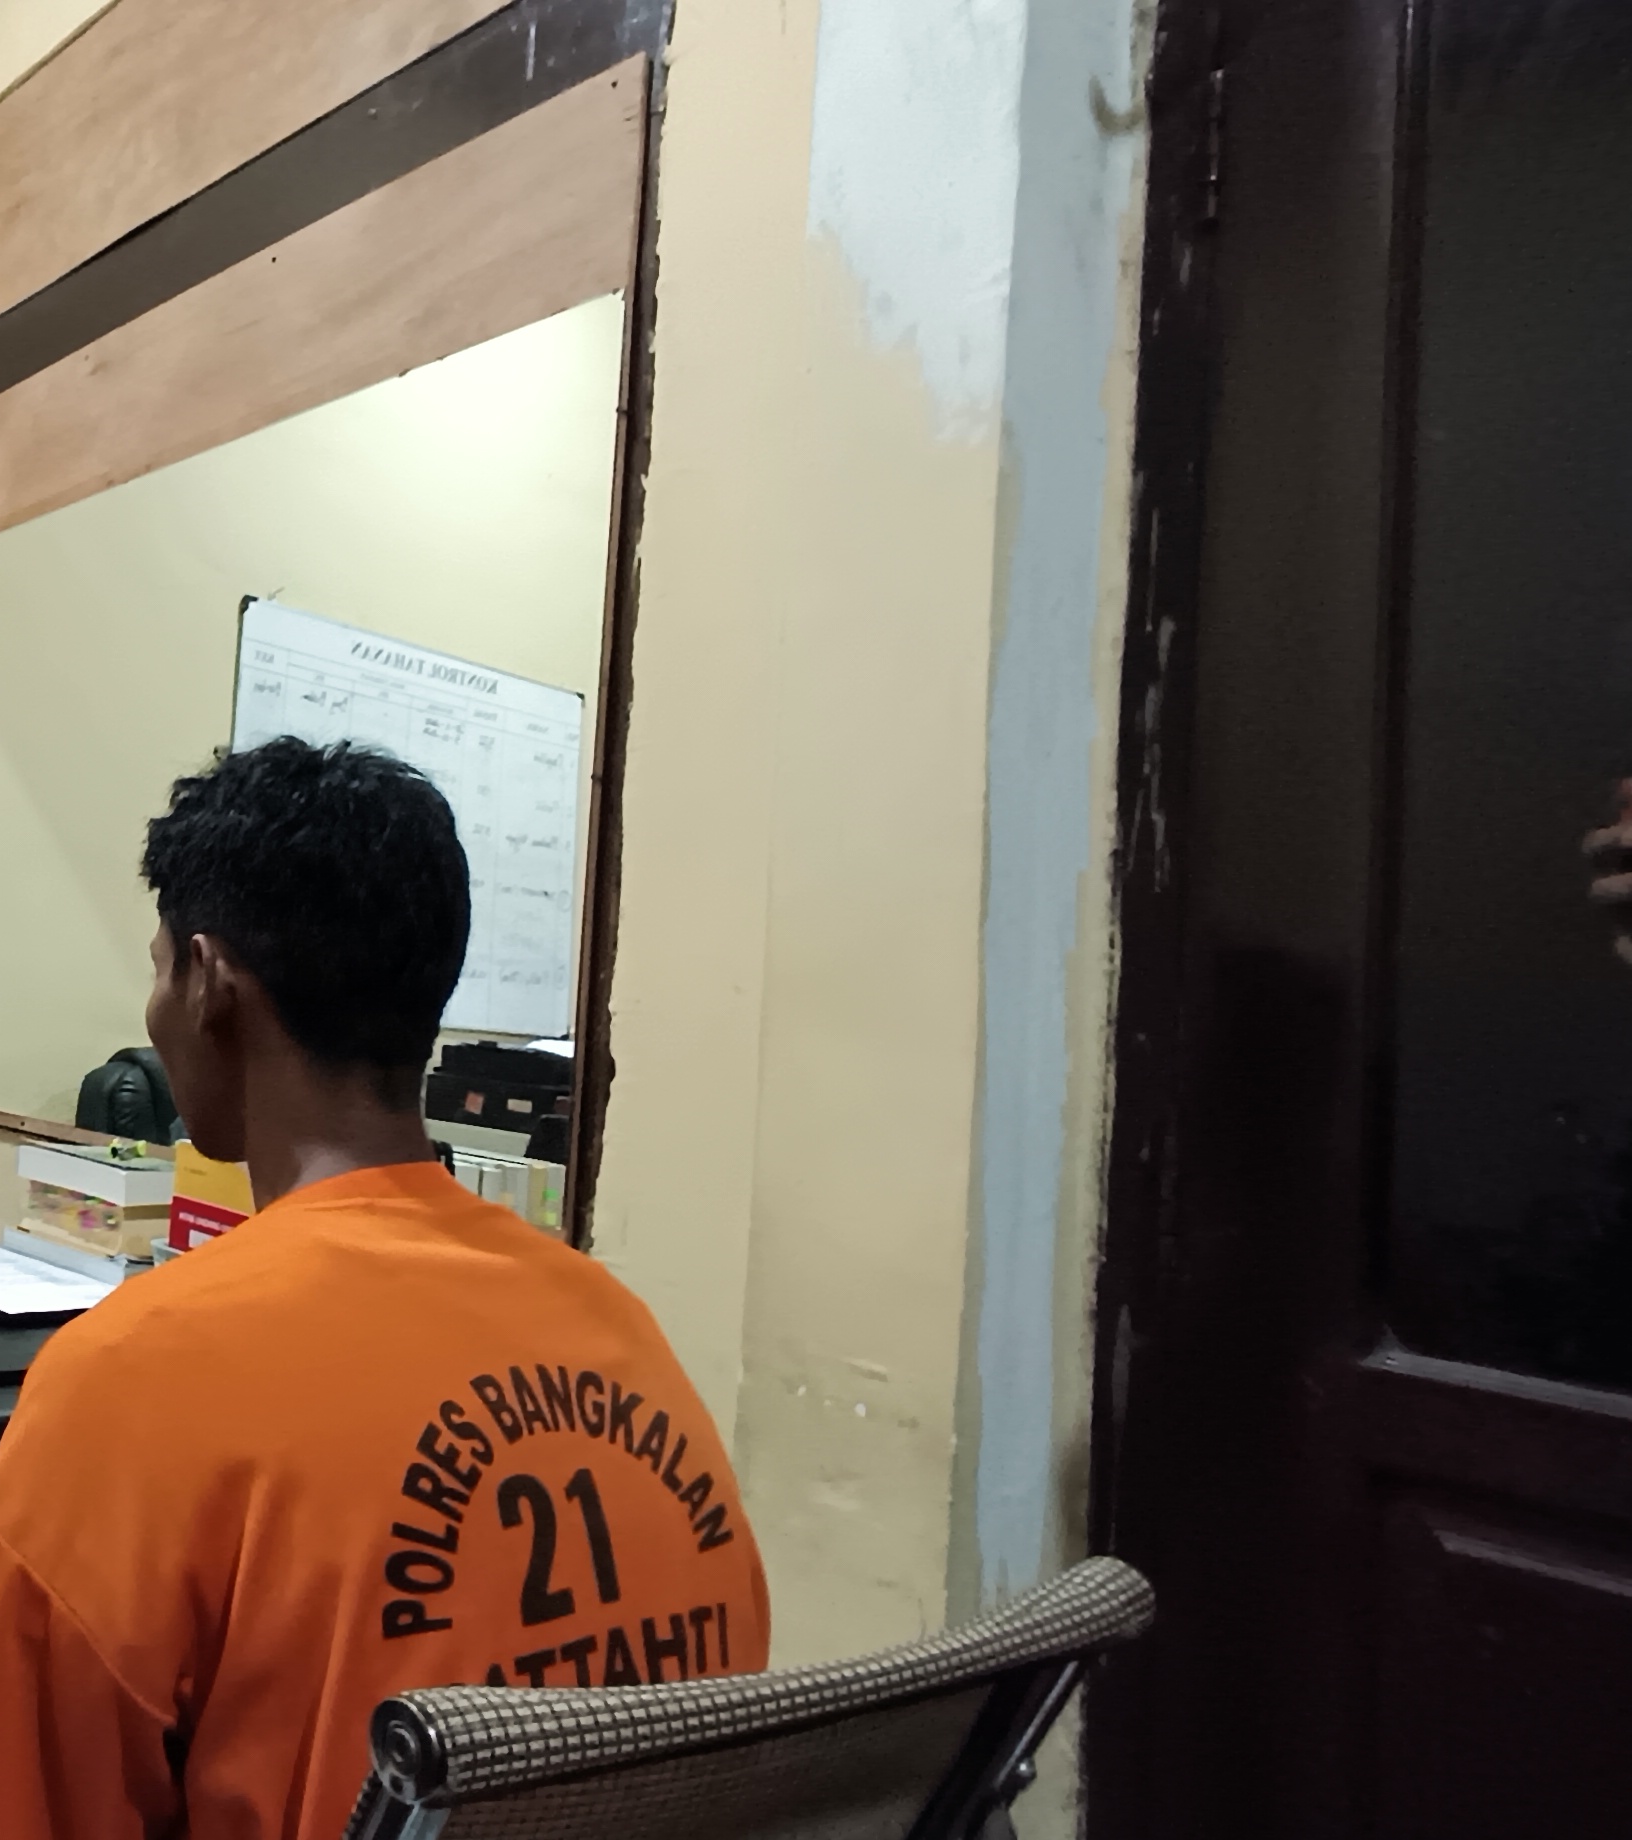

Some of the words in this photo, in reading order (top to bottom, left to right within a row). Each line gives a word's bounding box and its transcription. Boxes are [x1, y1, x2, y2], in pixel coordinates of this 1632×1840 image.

[381, 1400, 494, 1640] POLRES
[470, 1363, 734, 1554] BANGKALAN
[497, 1468, 621, 1628] 21
[450, 1603, 730, 1690] TTAHTI
